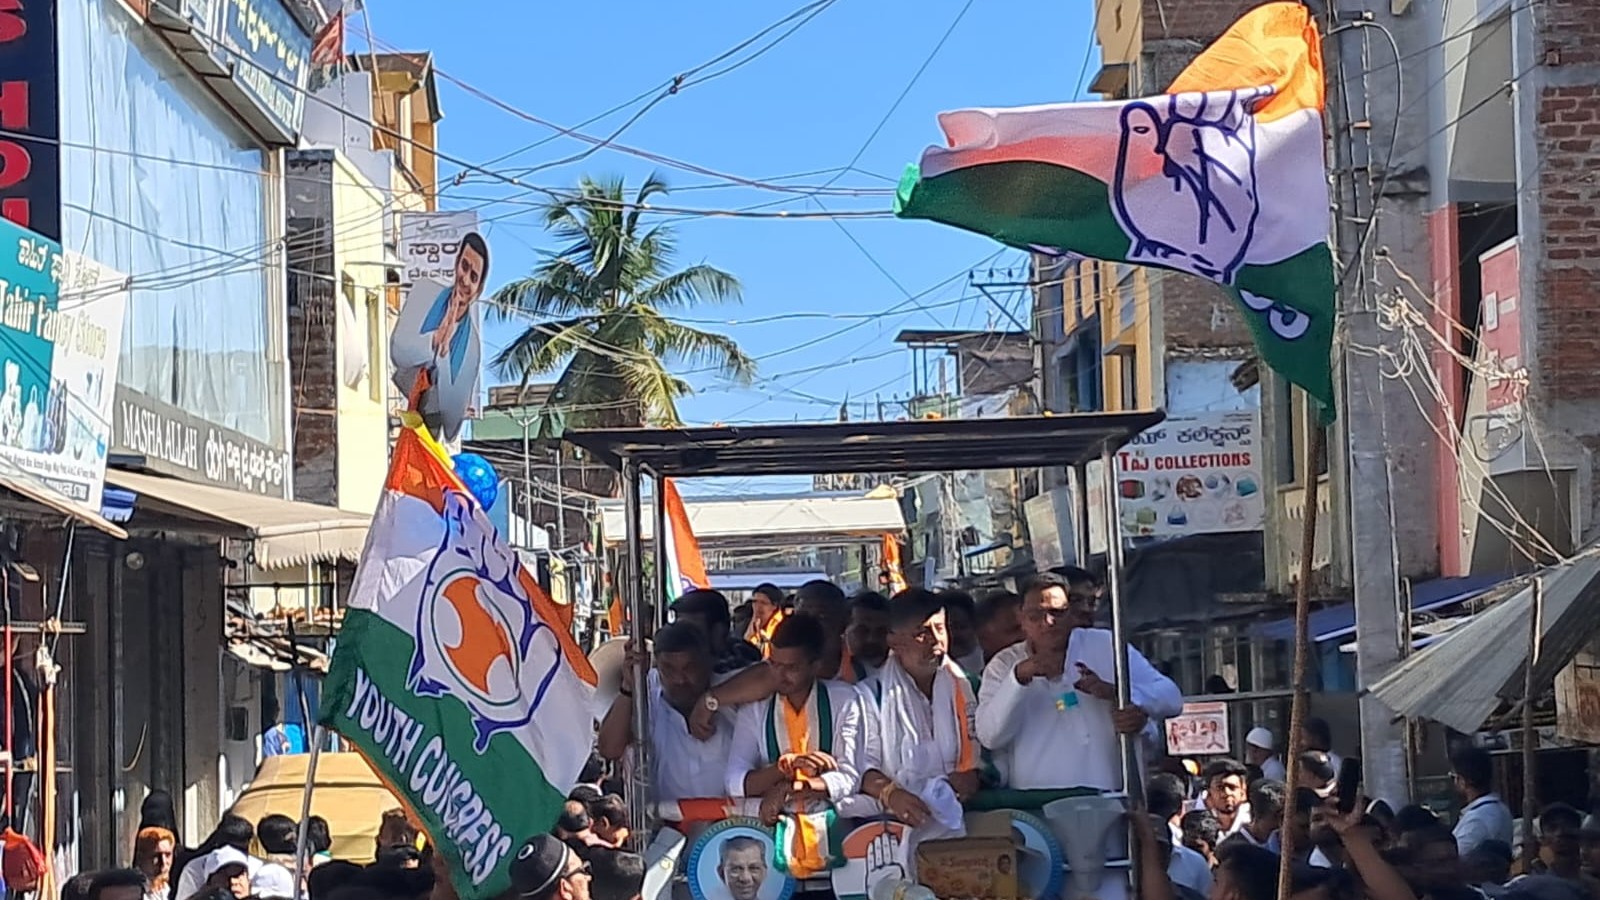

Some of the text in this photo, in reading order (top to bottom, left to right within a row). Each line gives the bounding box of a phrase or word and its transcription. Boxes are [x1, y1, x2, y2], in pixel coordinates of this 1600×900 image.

[1118, 452, 1251, 471] TAJ COLLECTIONS
[345, 666, 424, 774] YOUTH
